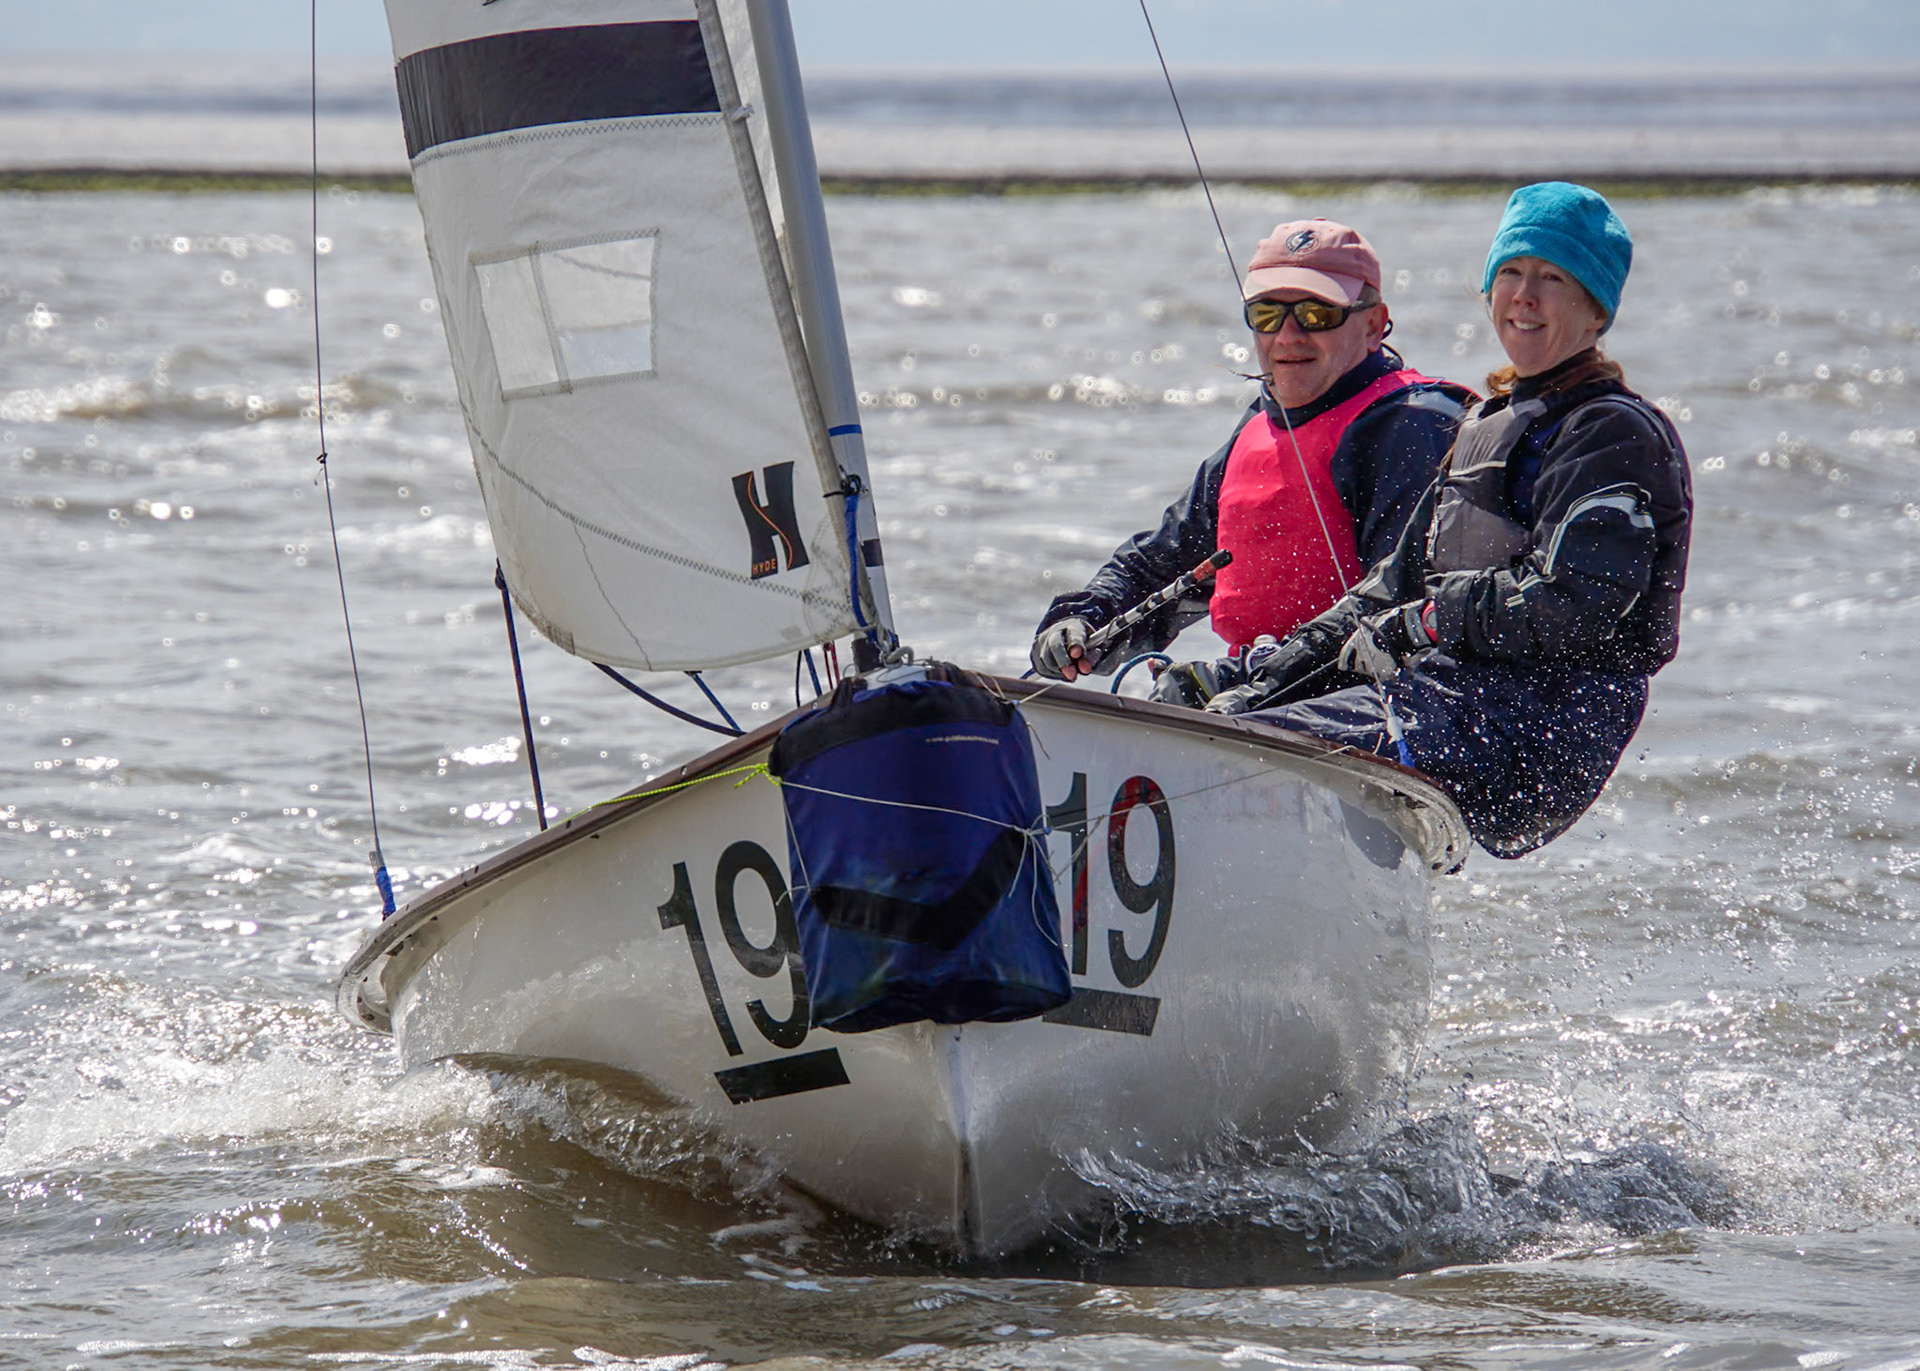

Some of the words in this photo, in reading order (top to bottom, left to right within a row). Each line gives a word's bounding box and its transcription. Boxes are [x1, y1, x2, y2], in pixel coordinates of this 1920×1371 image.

[731, 461, 810, 580] H
[752, 558, 777, 574] HYDE
[657, 840, 808, 1056] 19
[1045, 772, 1176, 988] 19
